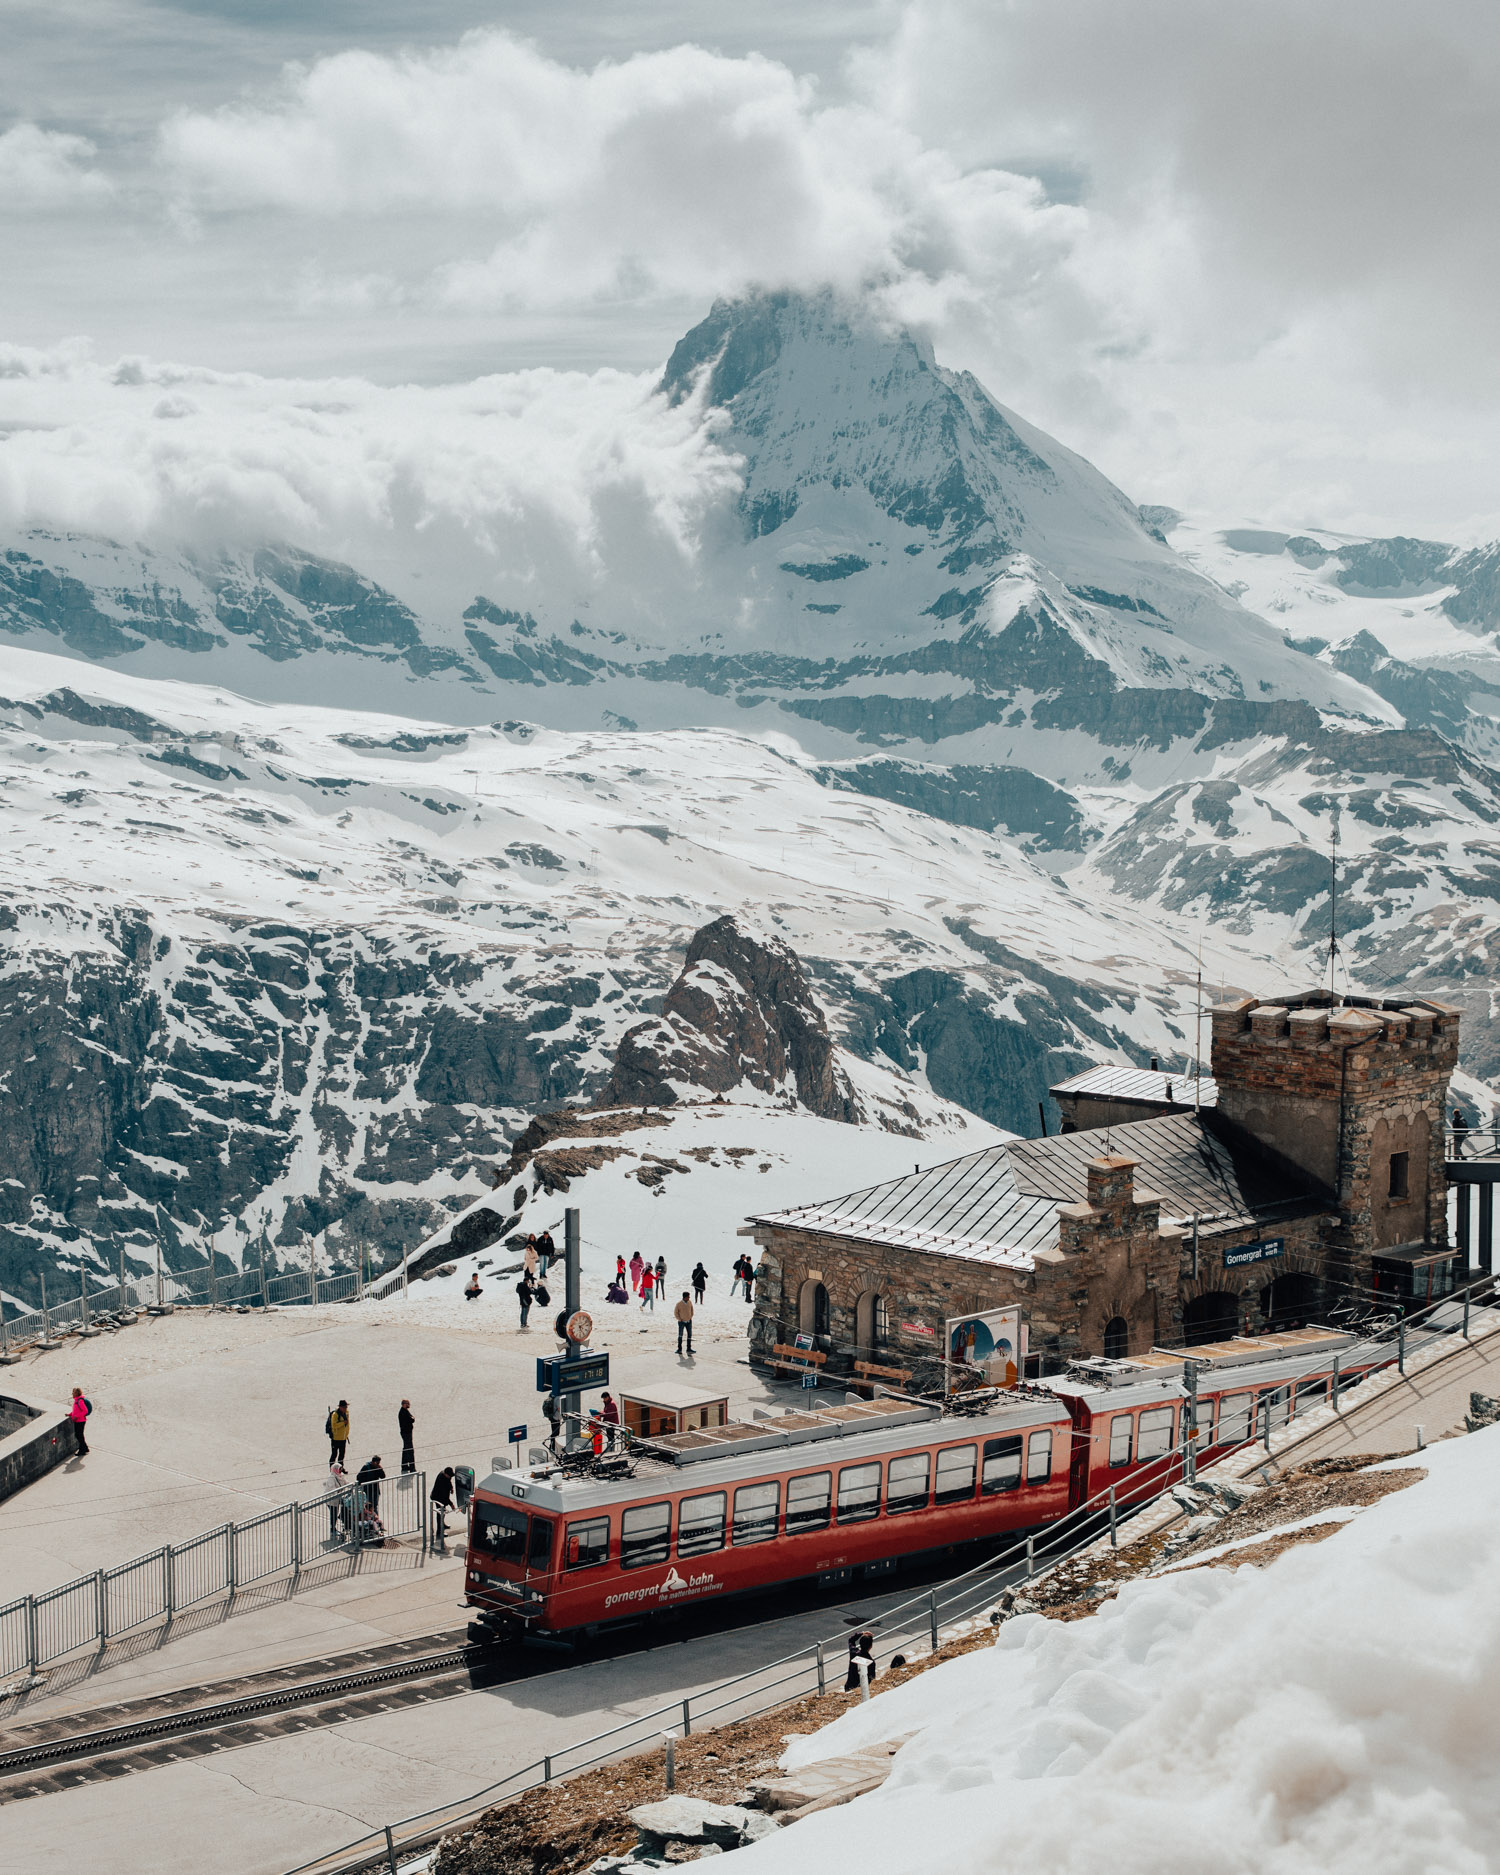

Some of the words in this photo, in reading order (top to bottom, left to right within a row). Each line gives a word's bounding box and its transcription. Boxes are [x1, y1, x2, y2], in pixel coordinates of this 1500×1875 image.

[1227, 1248, 1262, 1264] Gornergrat
[584, 1368, 603, 1379] 17:18
[605, 1584, 659, 1608] gornergrat
[689, 1572, 714, 1587] bahn
[658, 1593, 668, 1602] the
[669, 1587, 701, 1600] matterhorn
[701, 1582, 724, 1593] railway
